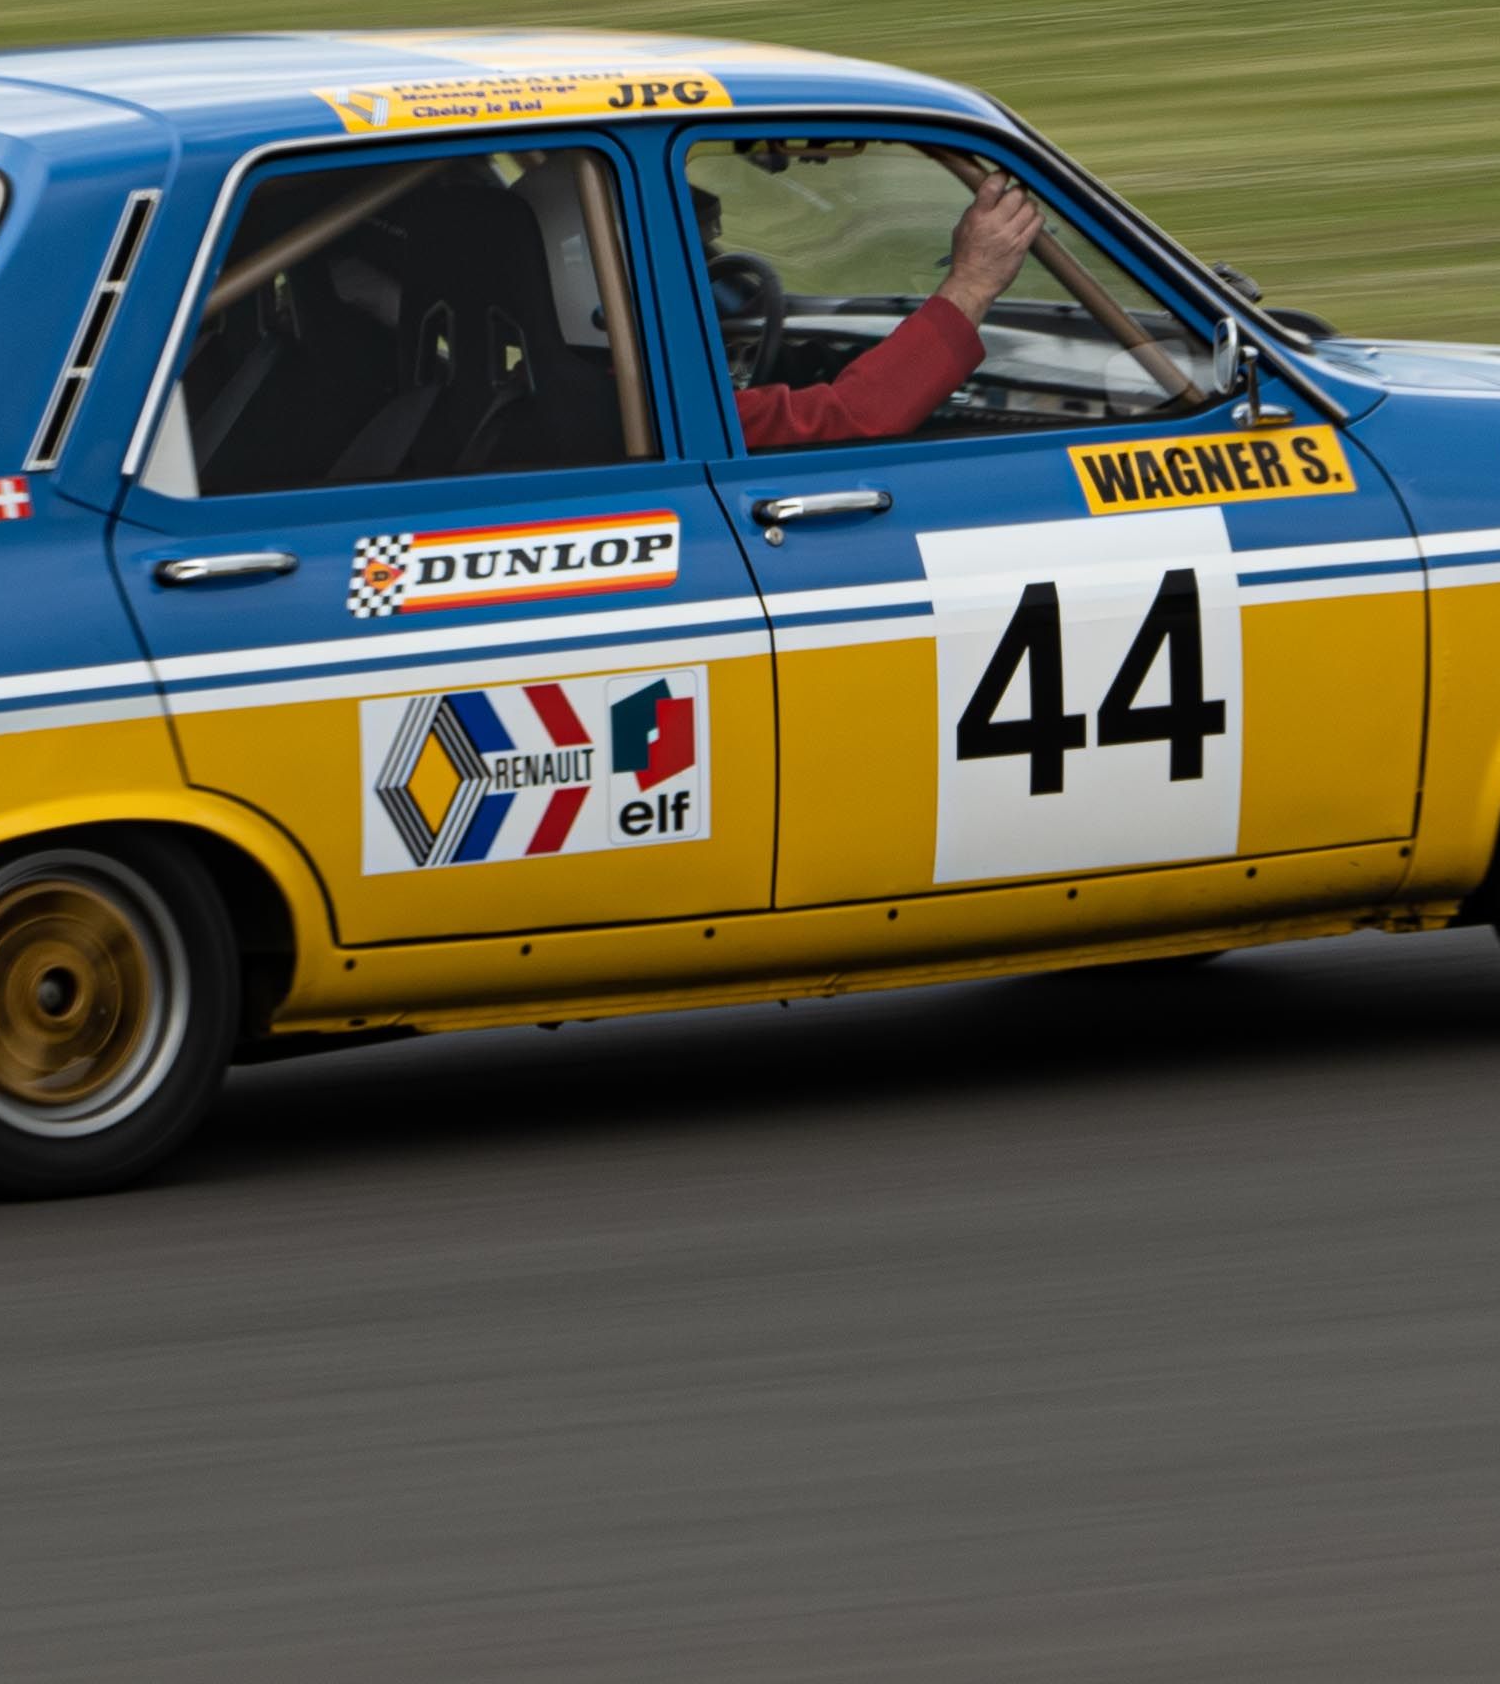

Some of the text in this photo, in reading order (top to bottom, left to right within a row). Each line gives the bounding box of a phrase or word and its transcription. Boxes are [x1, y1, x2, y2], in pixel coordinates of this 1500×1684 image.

[412, 99, 542, 119] Choisy le Roi
[608, 80, 708, 108] JPG
[1082, 437, 1343, 503] WAGNER S.
[415, 533, 673, 585] DUNLOP
[957, 568, 1226, 796] 44
[495, 748, 594, 790] RENAULT
[619, 791, 691, 836] elf
